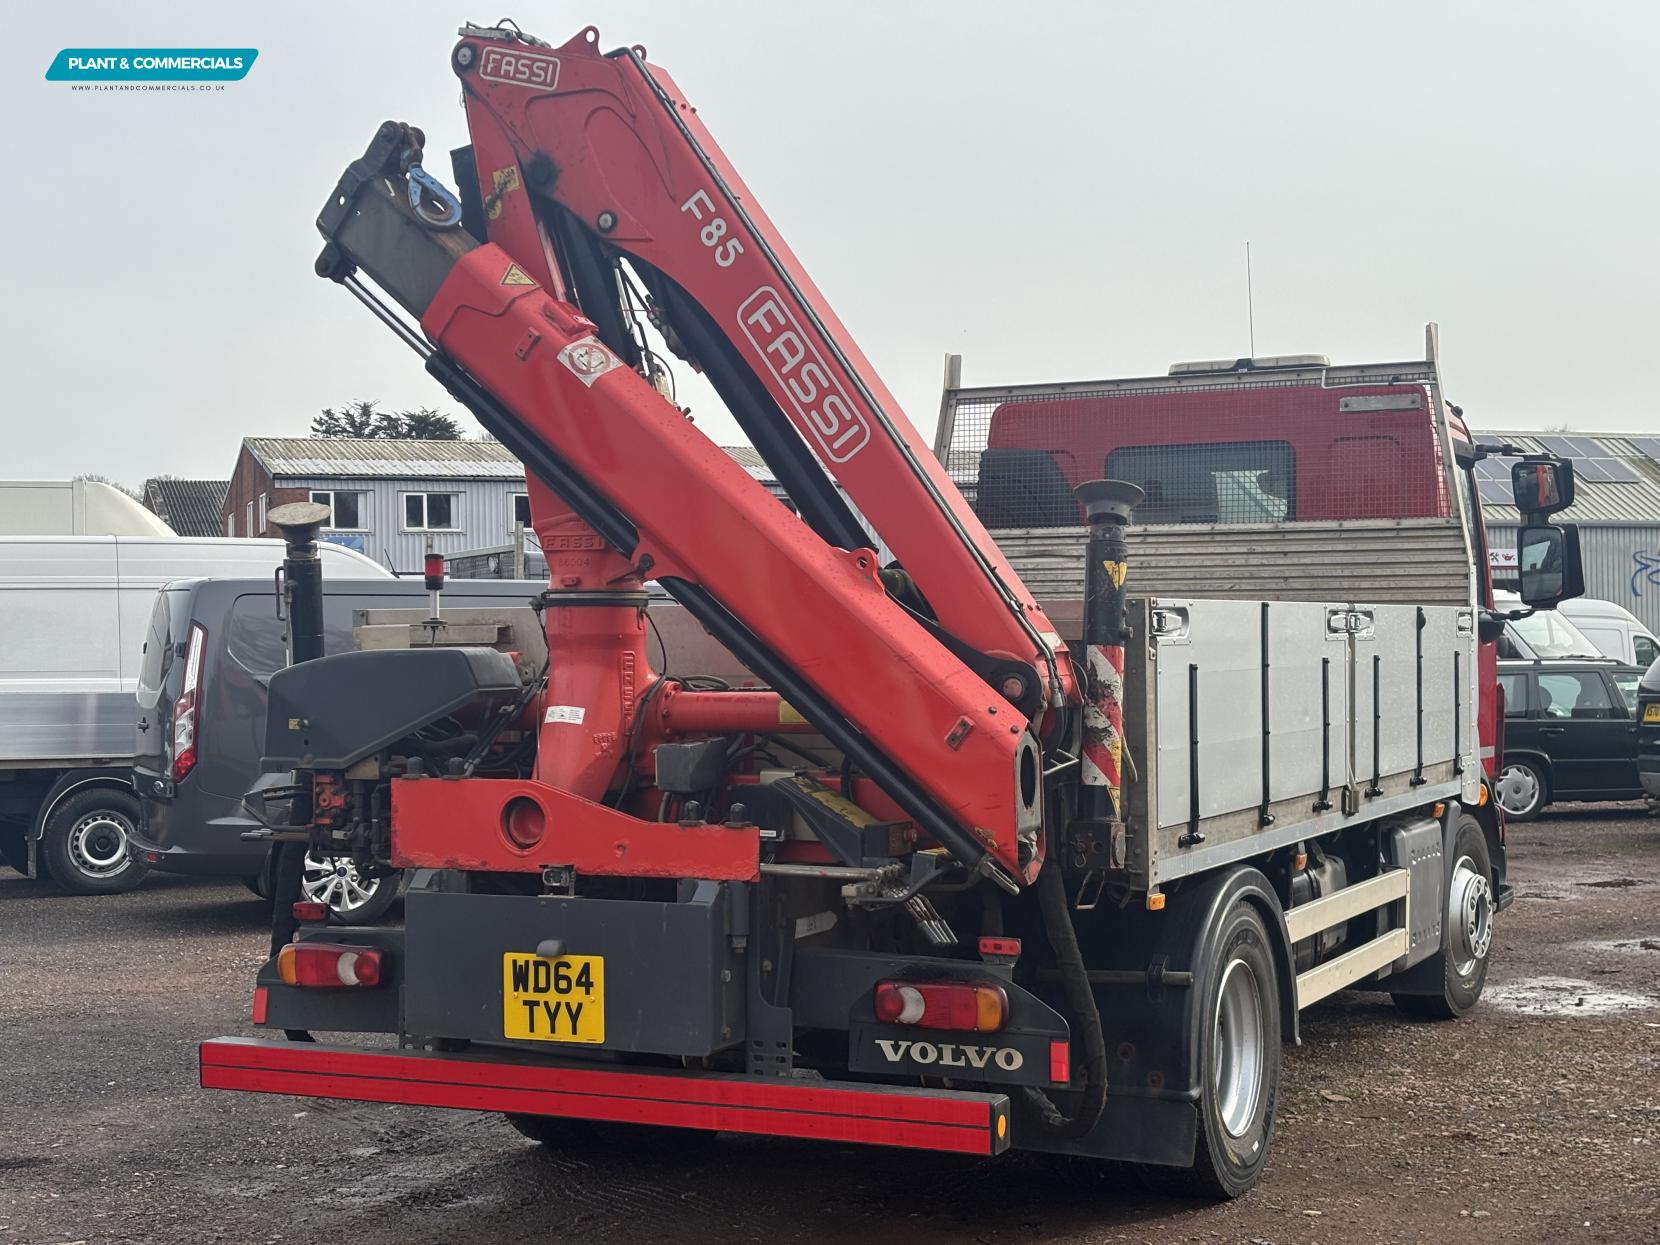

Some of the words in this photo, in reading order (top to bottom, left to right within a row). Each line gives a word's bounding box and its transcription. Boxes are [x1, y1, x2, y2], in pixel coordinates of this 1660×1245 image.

[487, 53, 553, 84] FASSI
[681, 189, 744, 268] F85
[747, 300, 860, 450] FASSI
[545, 535, 602, 549] FASSI
[511, 959, 595, 996] WD64
[522, 999, 584, 1036] TYY
[874, 1039, 1024, 1071] VOLVO
